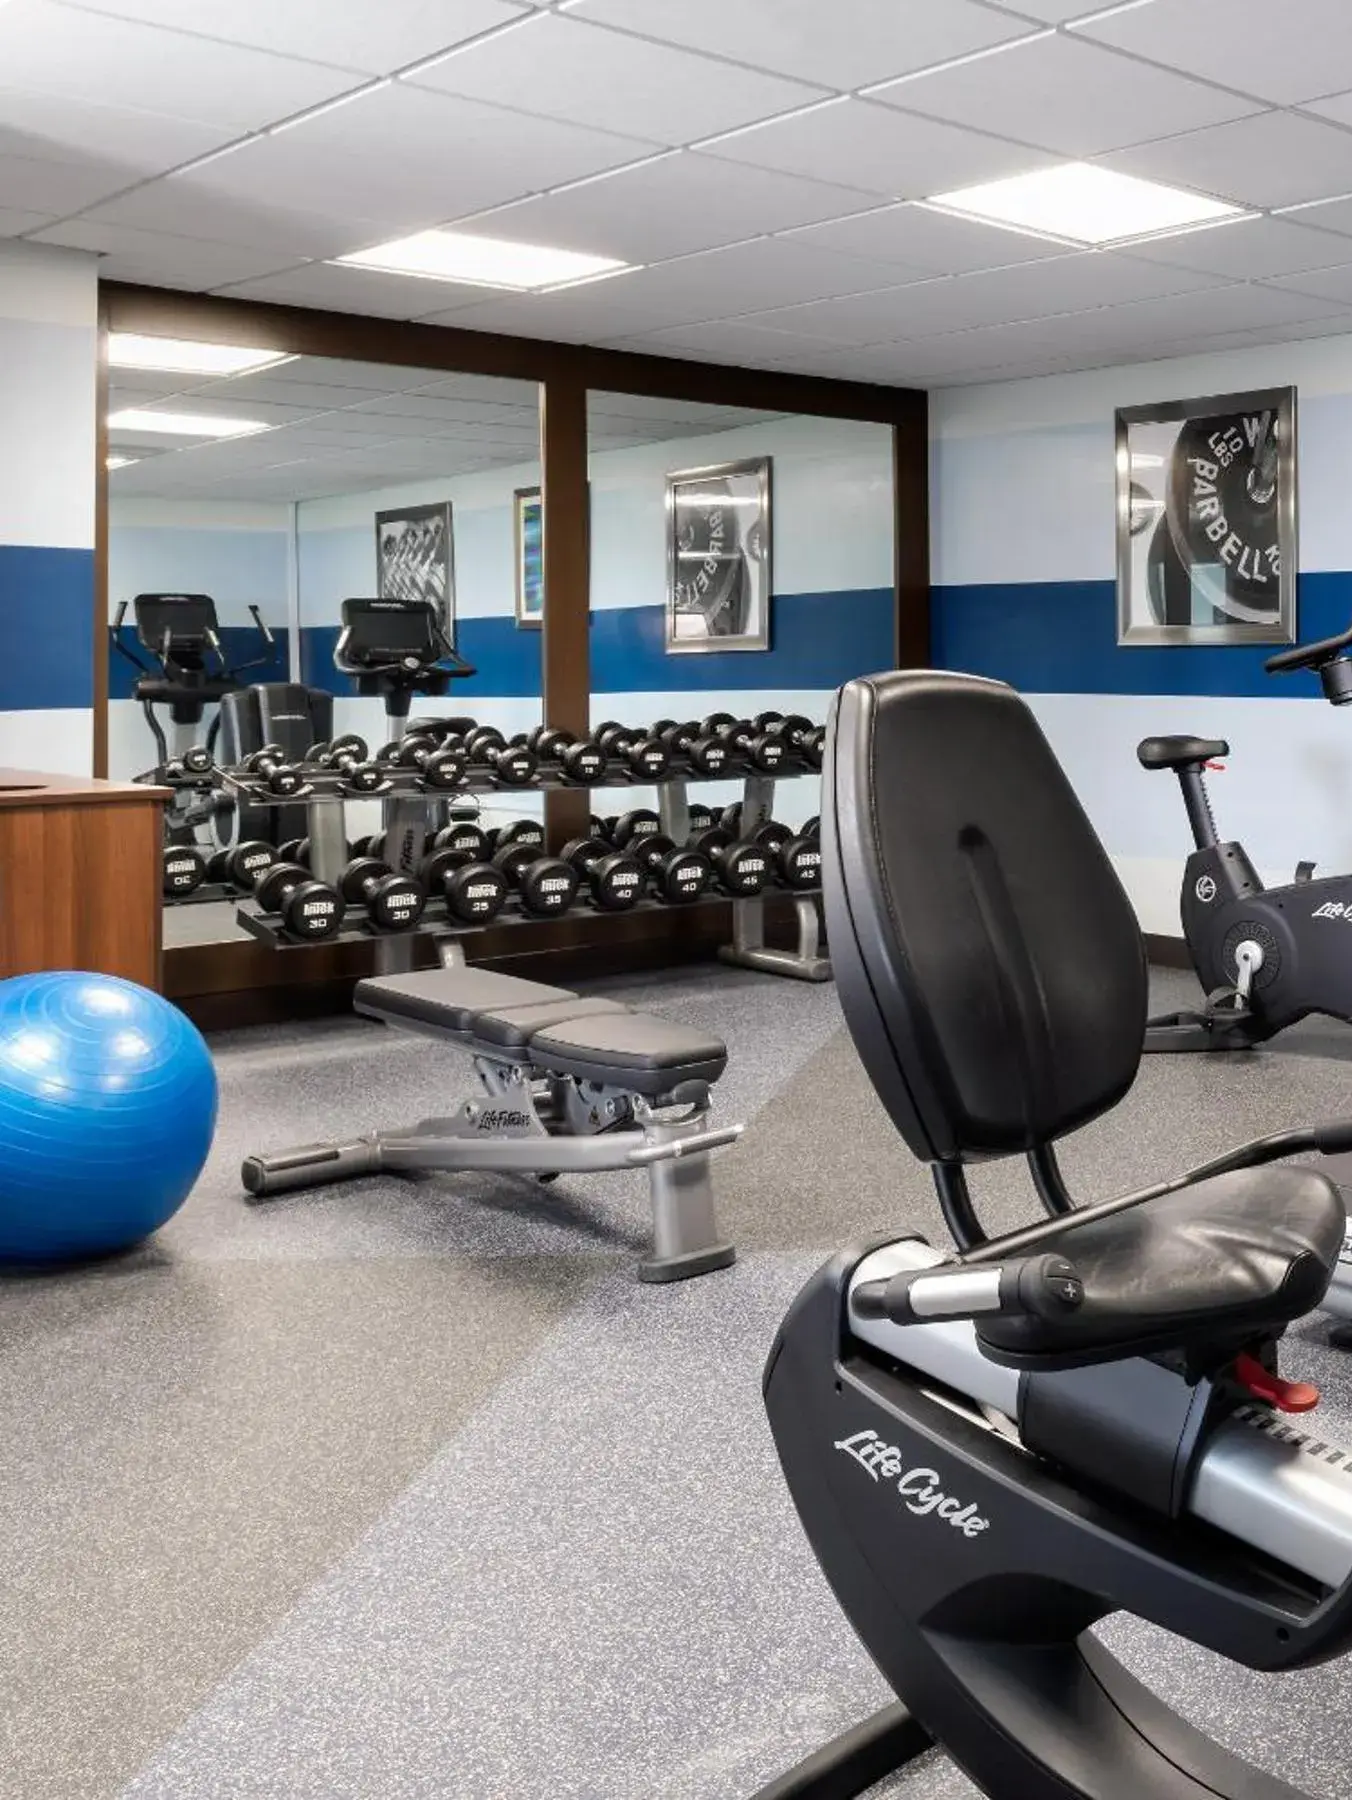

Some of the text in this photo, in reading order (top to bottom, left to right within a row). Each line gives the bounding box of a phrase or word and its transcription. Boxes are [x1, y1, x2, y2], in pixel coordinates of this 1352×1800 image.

[1208, 431, 1233, 468] LBS
[1223, 427, 1244, 453] 10
[1193, 457, 1267, 582] BARBELL
[616, 889, 632, 898] 40
[682, 882, 697, 891] 40
[833, 1430, 990, 1538] Life Cycle
